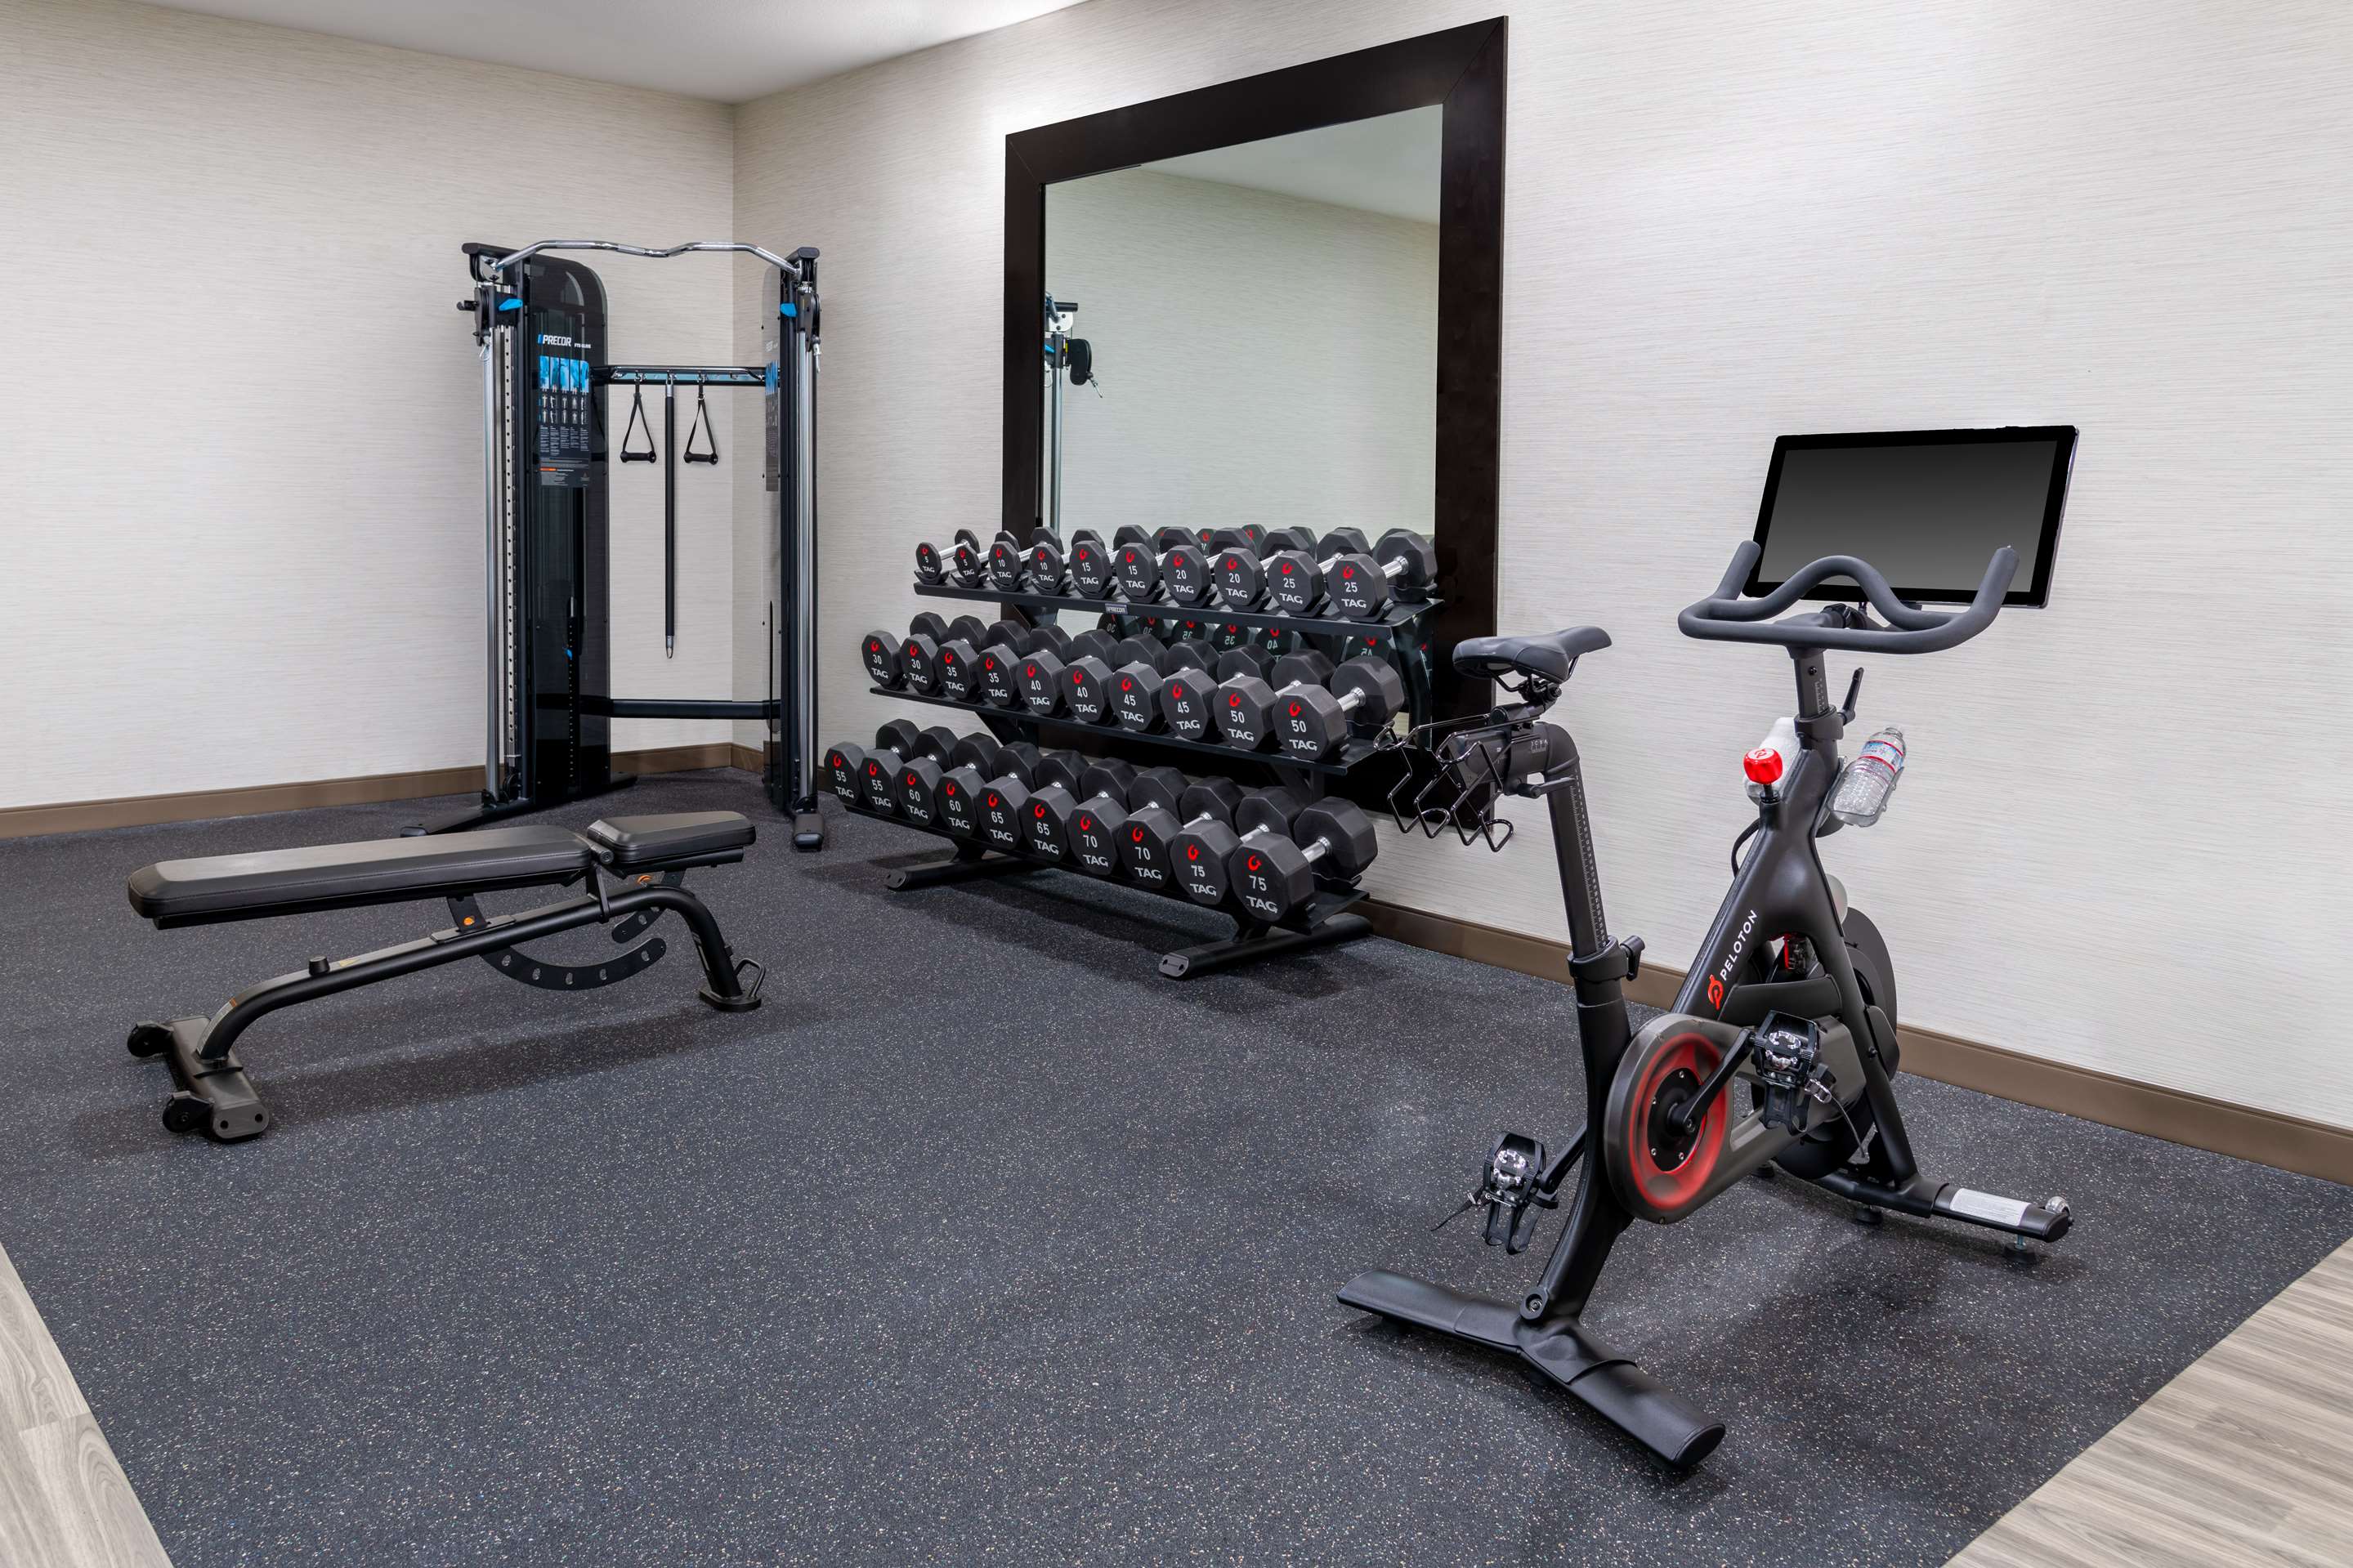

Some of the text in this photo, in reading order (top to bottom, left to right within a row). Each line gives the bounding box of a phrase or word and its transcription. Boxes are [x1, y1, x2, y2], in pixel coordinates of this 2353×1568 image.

[542, 334, 571, 347] PRECOR
[998, 559, 1005, 568] 10
[1040, 561, 1048, 571] 10
[1082, 561, 1091, 571] 15
[1129, 565, 1138, 575] 15
[1176, 570, 1187, 579] 20
[1080, 577, 1098, 585] TAG
[1228, 573, 1241, 583] 20
[1283, 578, 1295, 588] 25
[1126, 580, 1145, 589] TAG
[1174, 585, 1194, 594] TAG
[1344, 582, 1358, 593] 25
[1226, 588, 1248, 598] TAG
[1280, 593, 1303, 604] TAG
[1342, 598, 1367, 608] TAG
[873, 654, 882, 665] 30
[911, 658, 921, 670] 30
[872, 668, 888, 679] TAG
[947, 666, 957, 677] 35
[989, 672, 1000, 683] 35
[910, 672, 928, 684] TAG
[946, 681, 964, 692] TAG
[1031, 680, 1041, 691] 40
[988, 689, 1007, 698] TAG
[1076, 687, 1088, 698] 40
[1030, 696, 1050, 706] TAG
[1124, 695, 1136, 706] 45
[1076, 704, 1097, 713] TAG
[1178, 702, 1190, 713] 45
[1121, 711, 1144, 723] TAG
[1231, 711, 1245, 724] 50
[1177, 719, 1200, 730] TAG
[1291, 719, 1307, 733] 50
[1228, 728, 1254, 741] TAG
[1289, 739, 1317, 752] TAG
[835, 770, 847, 783] 55
[871, 780, 883, 792] 55
[835, 786, 854, 799] TAG
[909, 788, 920, 802] 60
[871, 796, 892, 808] TAG
[950, 799, 961, 812] 60
[907, 804, 928, 820] TAG
[991, 811, 1004, 824] 65
[948, 817, 970, 830] TAG
[1036, 821, 1050, 836] 65
[991, 829, 1013, 842] TAG
[1083, 834, 1098, 848] 70
[1035, 839, 1059, 855] TAG
[1134, 847, 1151, 860] 70
[1083, 855, 1108, 868] TAG
[1134, 867, 1162, 880] TAG
[1191, 864, 1206, 878] 75
[1190, 883, 1216, 896] TAG
[1249, 875, 1267, 892] 75
[1246, 896, 1278, 914] TAG
[1720, 909, 1758, 981] PELOTON
